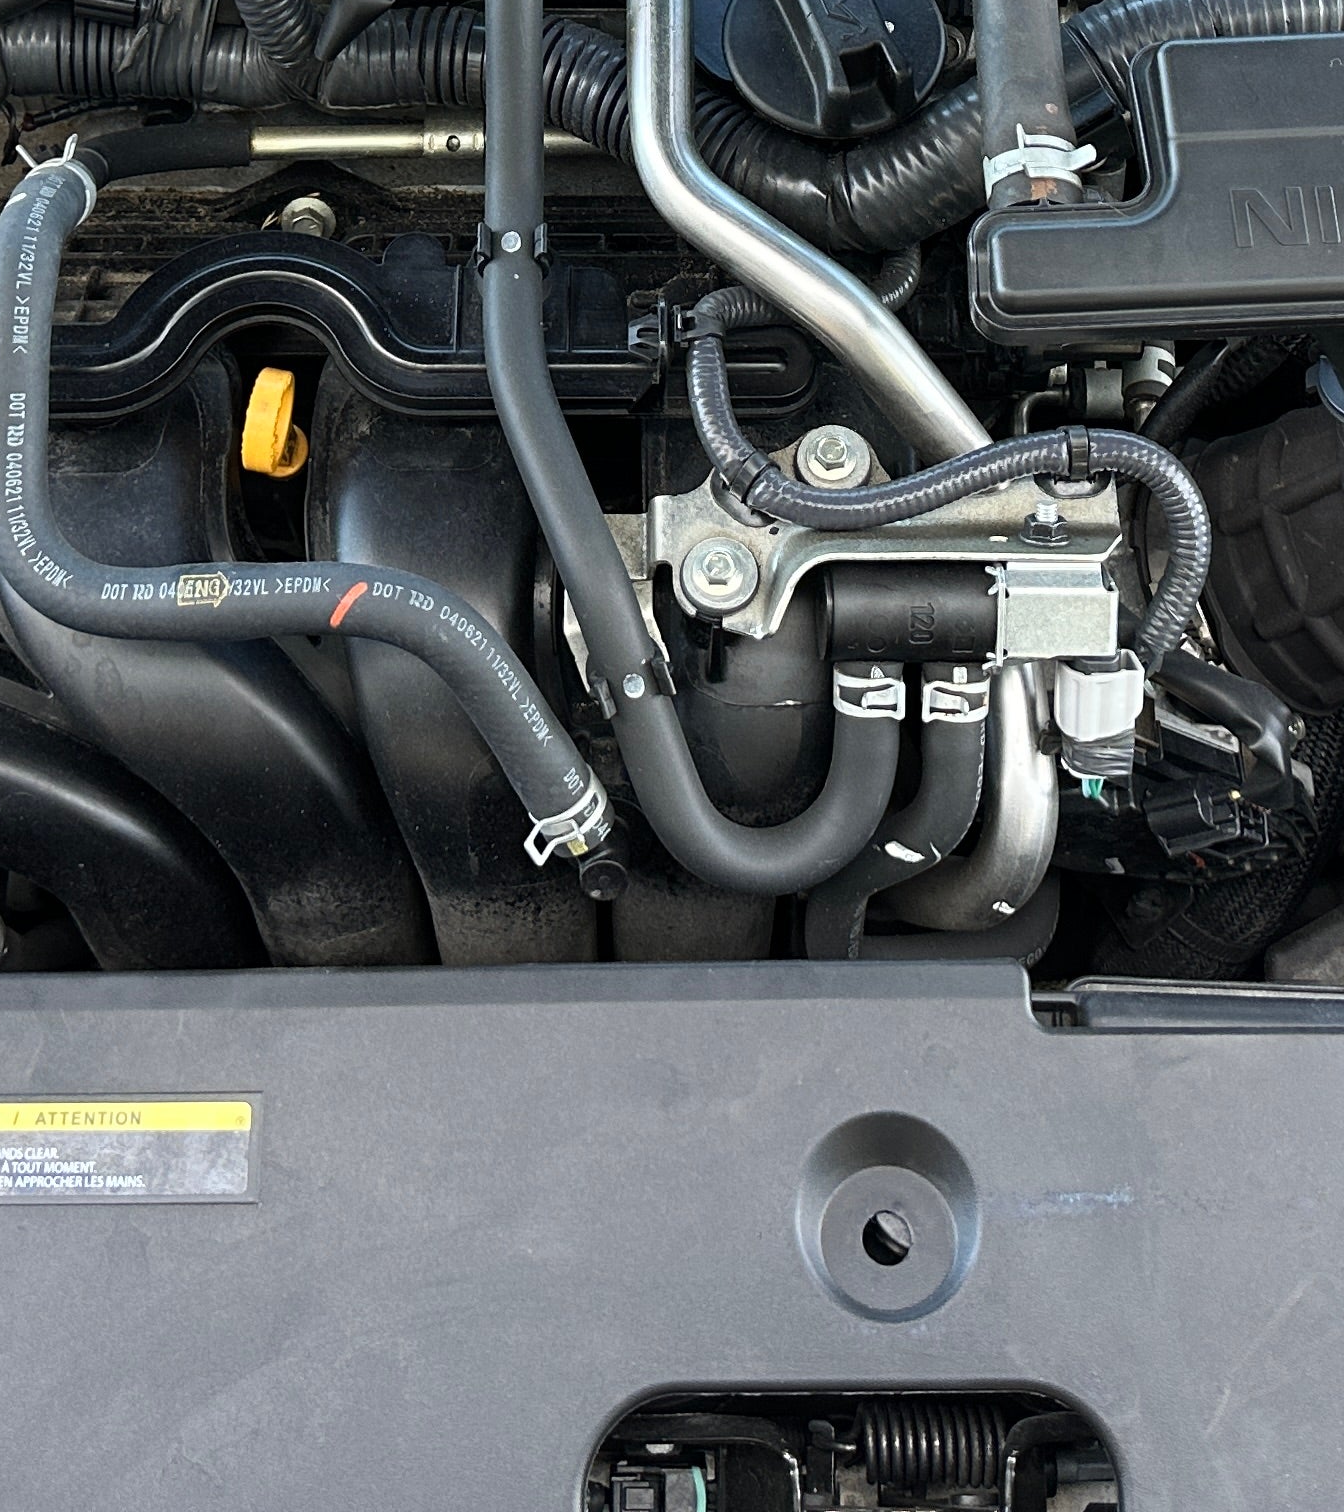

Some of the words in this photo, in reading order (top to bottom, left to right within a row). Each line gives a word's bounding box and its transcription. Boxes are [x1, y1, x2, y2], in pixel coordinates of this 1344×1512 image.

[25, 197, 51, 233] 040621
[15, 235, 38, 291] 11/32VL
[12, 295, 31, 355] >EPDM<
[9, 392, 27, 419] DOT
[4, 452, 23, 503] 040621
[6, 504, 37, 557] 11/32VL
[27, 550, 75, 589] >EPDM<
[274, 576, 333, 594] >EPDM<
[101, 582, 127, 600] DOT
[908, 601, 936, 645] 120
[372, 581, 405, 602] DOT
[439, 605, 488, 653] 040621
[485, 647, 523, 702] 11/32VL
[518, 695, 555, 748] >EPDM<
[562, 767, 586, 797] DOT
[35, 1111, 142, 1126] ATTENTION
[1, 1161, 9, 1174] À
[12, 1161, 41, 1174] TOUT
[44, 1161, 97, 1174] MOMENT.
[24, 1147, 59, 1160] CLEAR.
[14, 1175, 83, 1188] APPROCHER
[84, 1175, 104, 1188] LES
[106, 1175, 146, 1188] MAINS.
